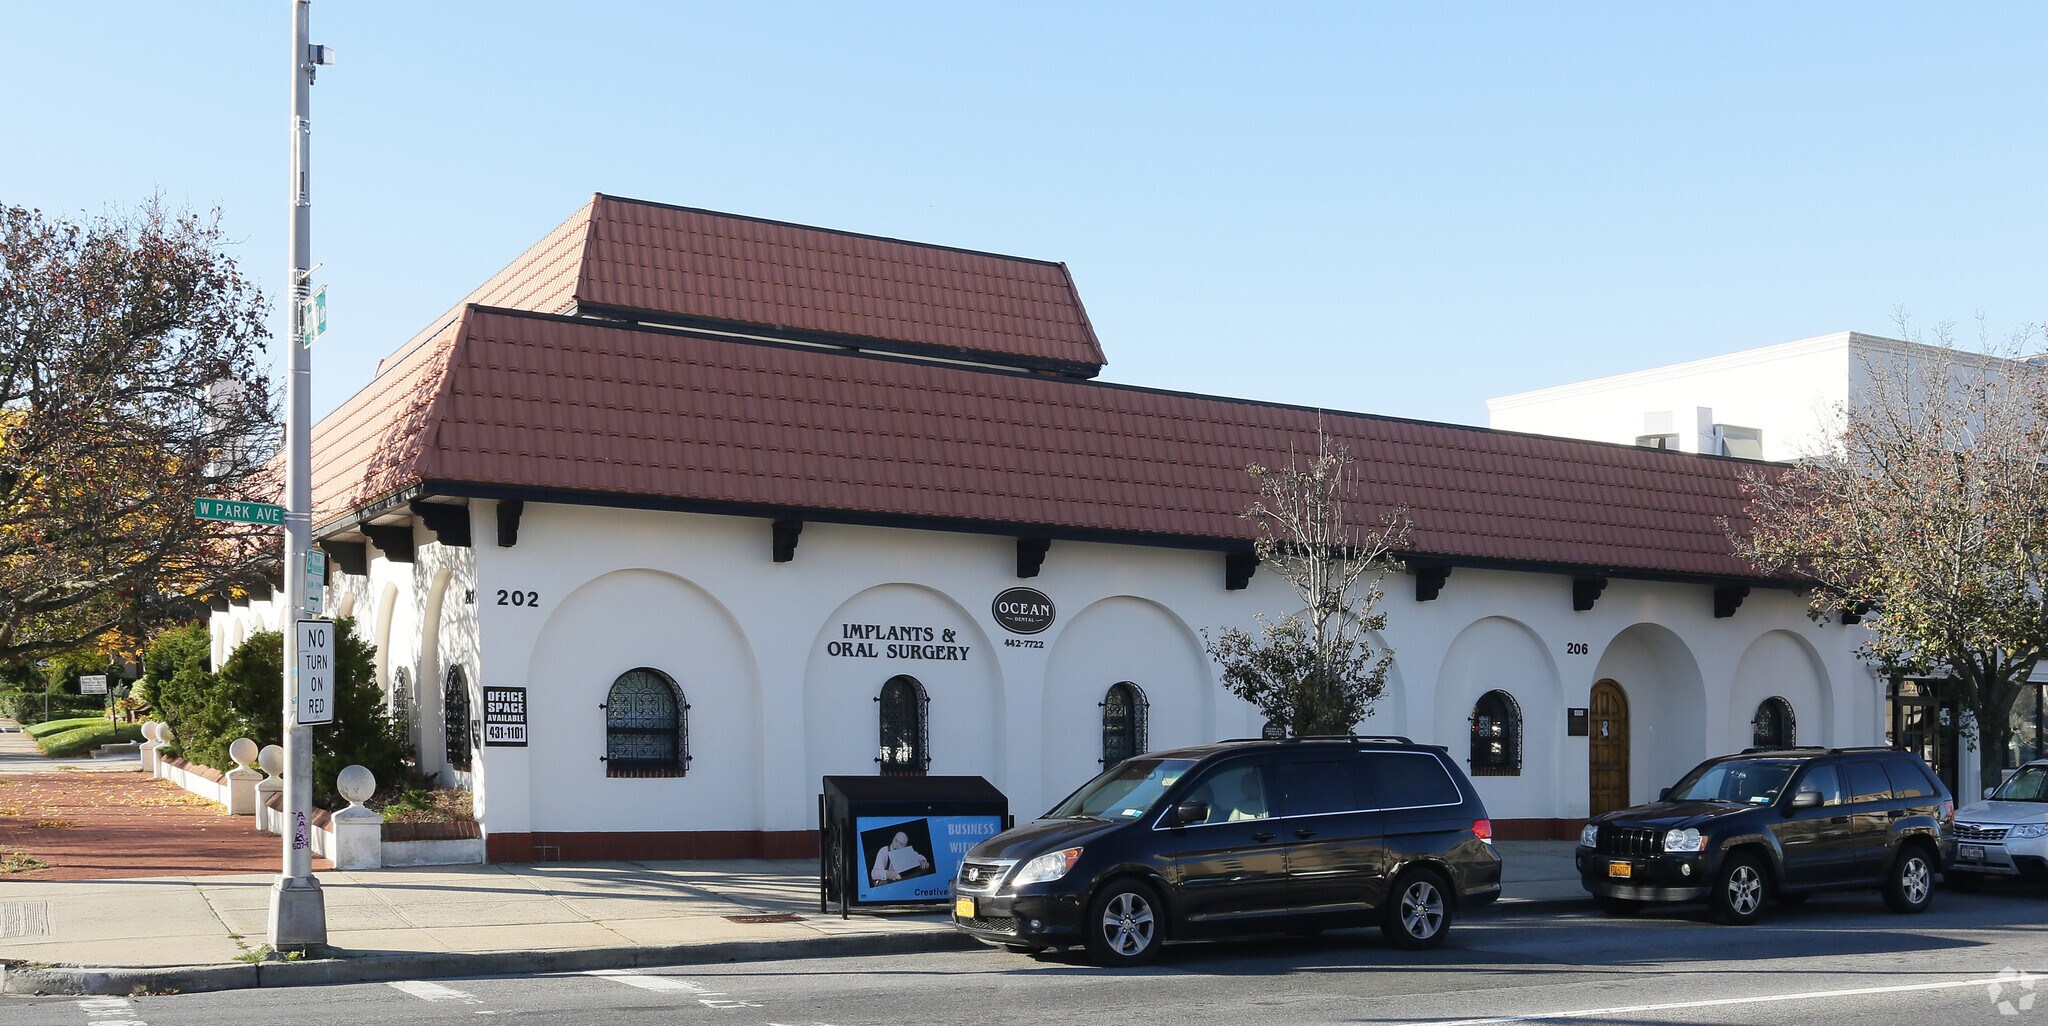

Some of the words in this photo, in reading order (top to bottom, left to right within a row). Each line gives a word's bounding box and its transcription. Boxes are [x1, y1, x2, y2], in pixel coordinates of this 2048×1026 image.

[200, 502, 209, 514] W
[216, 503, 250, 519] PARK
[256, 507, 280, 521] AVE
[497, 589, 539, 608] 202
[999, 601, 1050, 617] OCEAN
[308, 629, 325, 648] NO
[842, 623, 934, 642] IMPLANTS
[941, 628, 956, 643] &
[1004, 638, 1044, 649] 442-7722
[1567, 642, 1588, 655] 206
[827, 641, 879, 658] ORAL
[886, 643, 970, 661] SURGERY
[306, 655, 328, 670] TURN
[311, 677, 323, 691] ON
[1908, 684, 1924, 694] 210
[487, 691, 524, 702] OFFICE
[308, 698, 325, 714] RED
[487, 702, 524, 713] SPACE
[487, 714, 524, 722] AVAILABLE
[490, 726, 523, 739] 431-1101
[948, 823, 995, 836] BUSINESS
[914, 888, 948, 897] Creative
